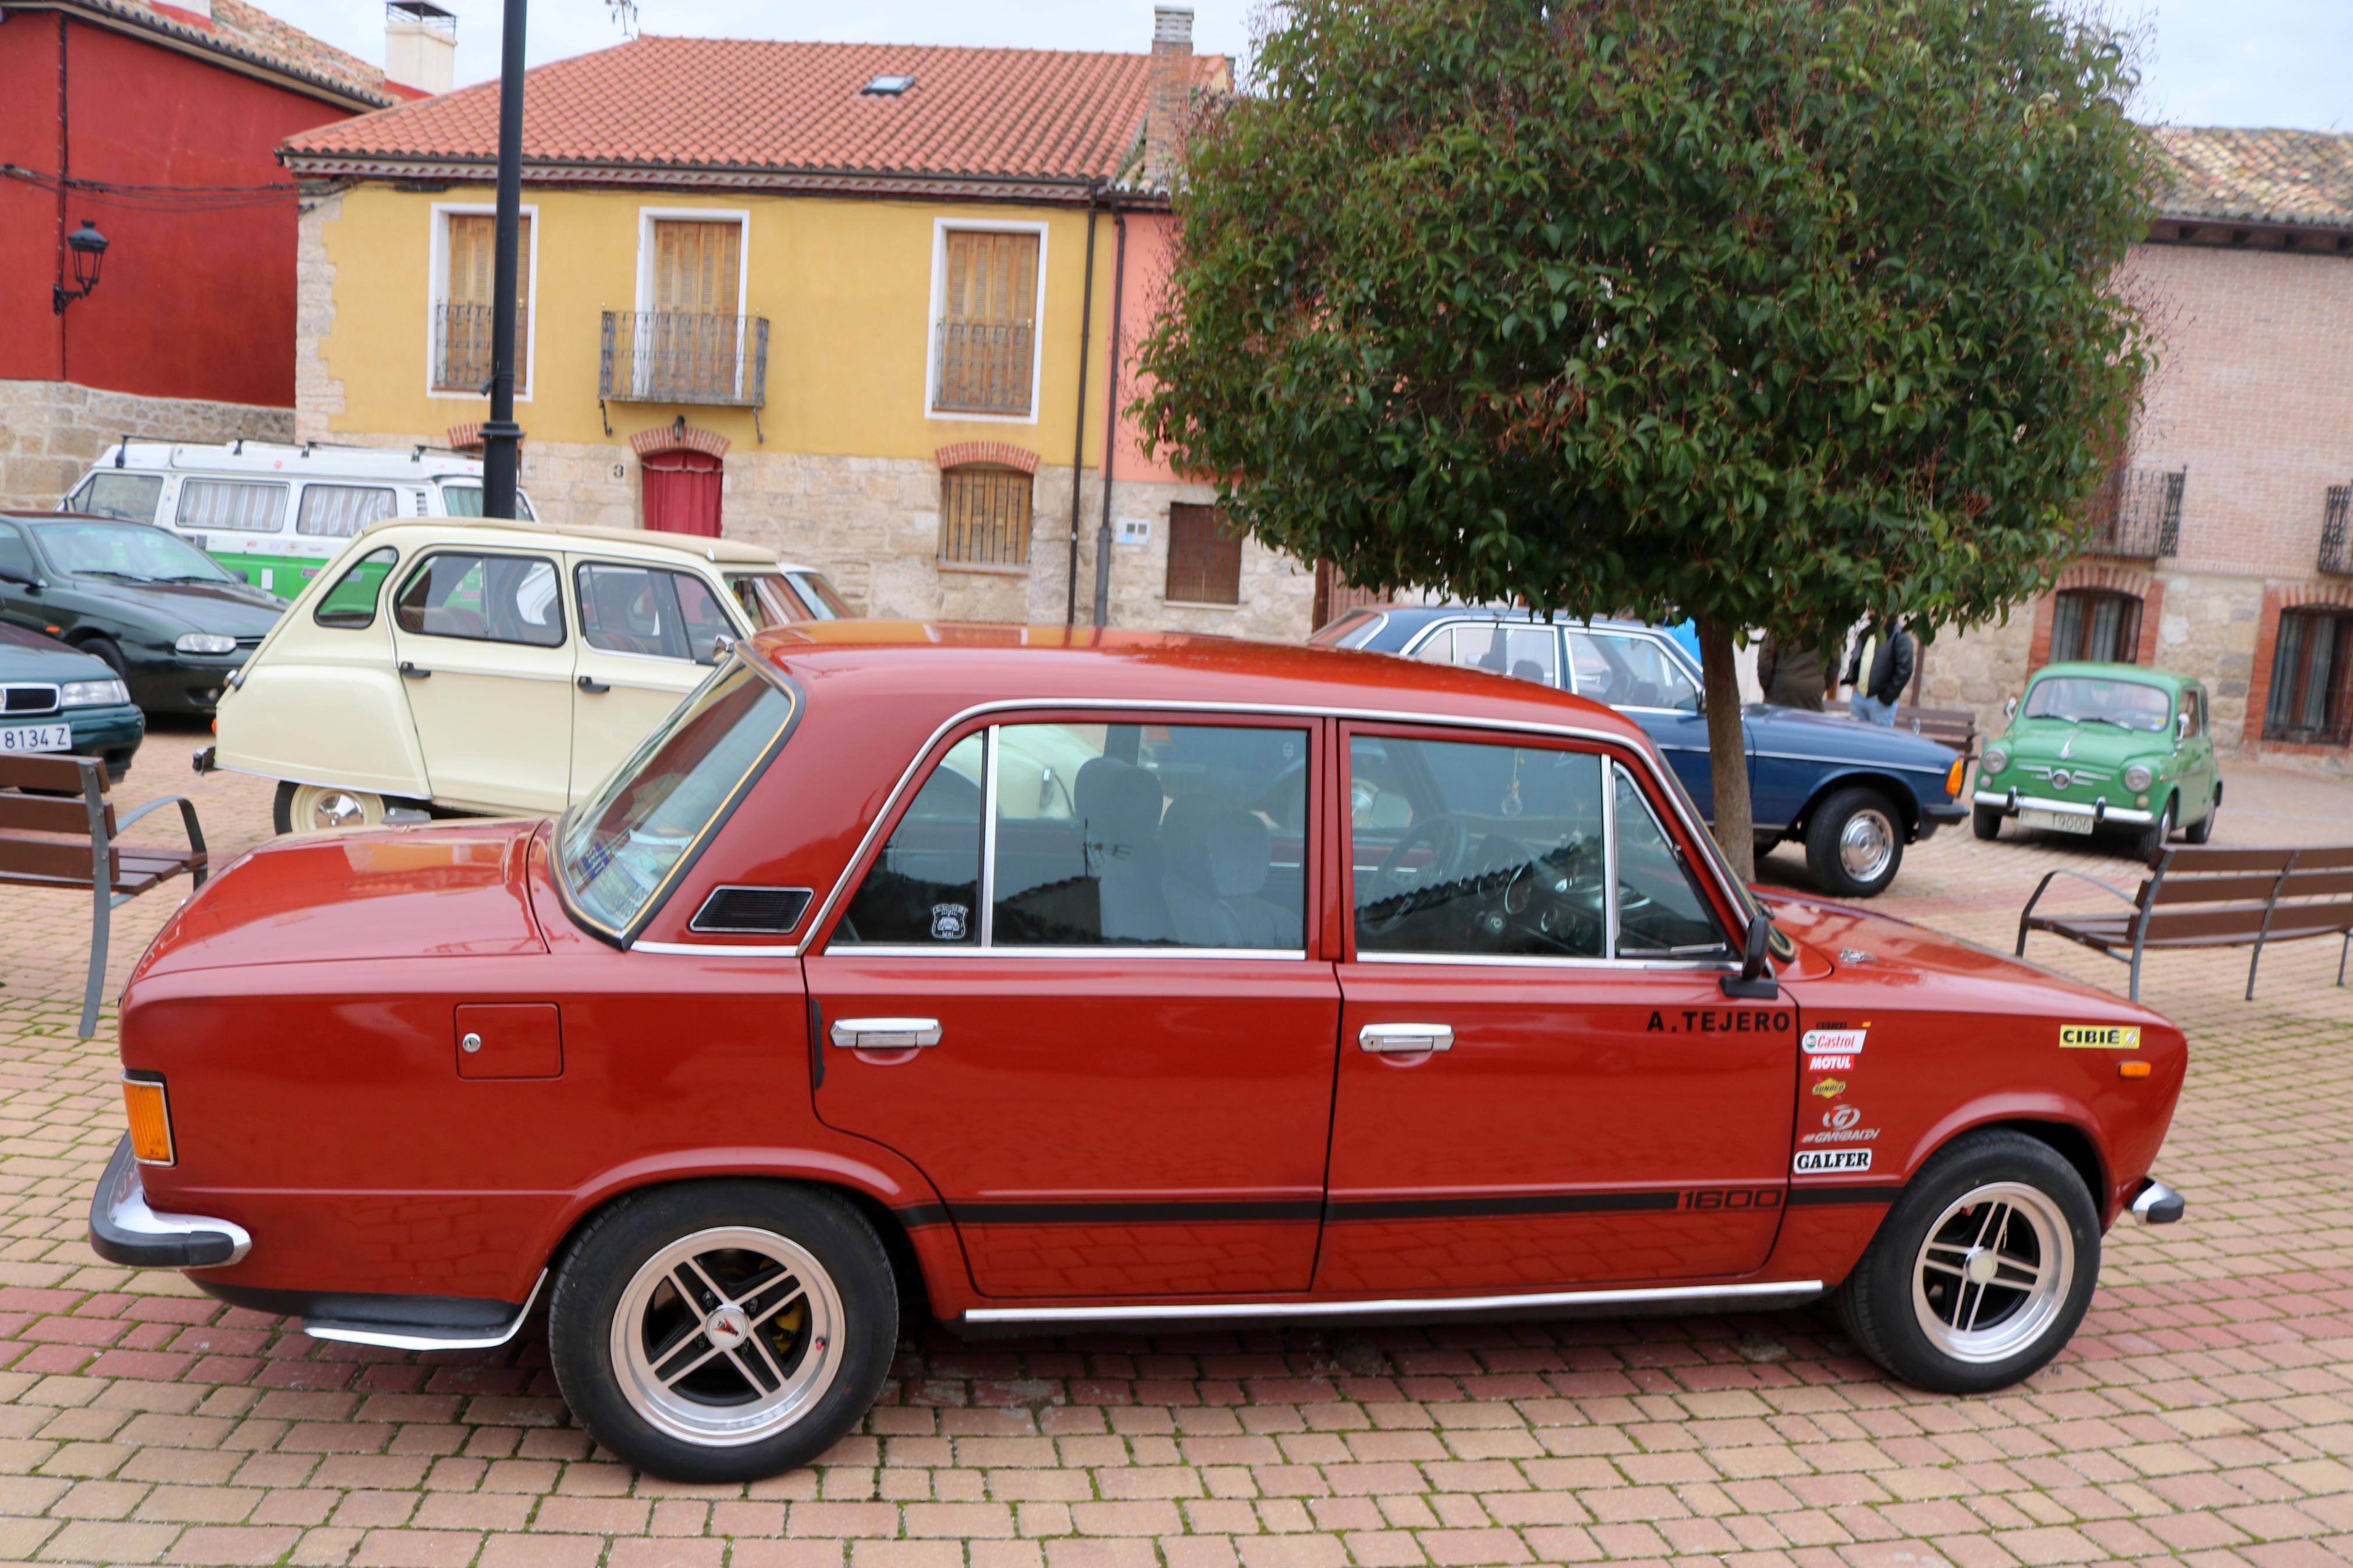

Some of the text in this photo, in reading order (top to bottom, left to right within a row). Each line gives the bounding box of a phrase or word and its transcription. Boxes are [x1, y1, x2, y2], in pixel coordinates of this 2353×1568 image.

[613, 464, 624, 479] 3
[5, 727, 67, 749] 8134 Z
[1818, 1034, 1855, 1048] Castrol
[1809, 1055, 1851, 1070] MOTUL
[1815, 1083, 1844, 1093] SUNOCO
[1797, 1152, 1869, 1169] GALFER
[1684, 1190, 1783, 1210] 1600
